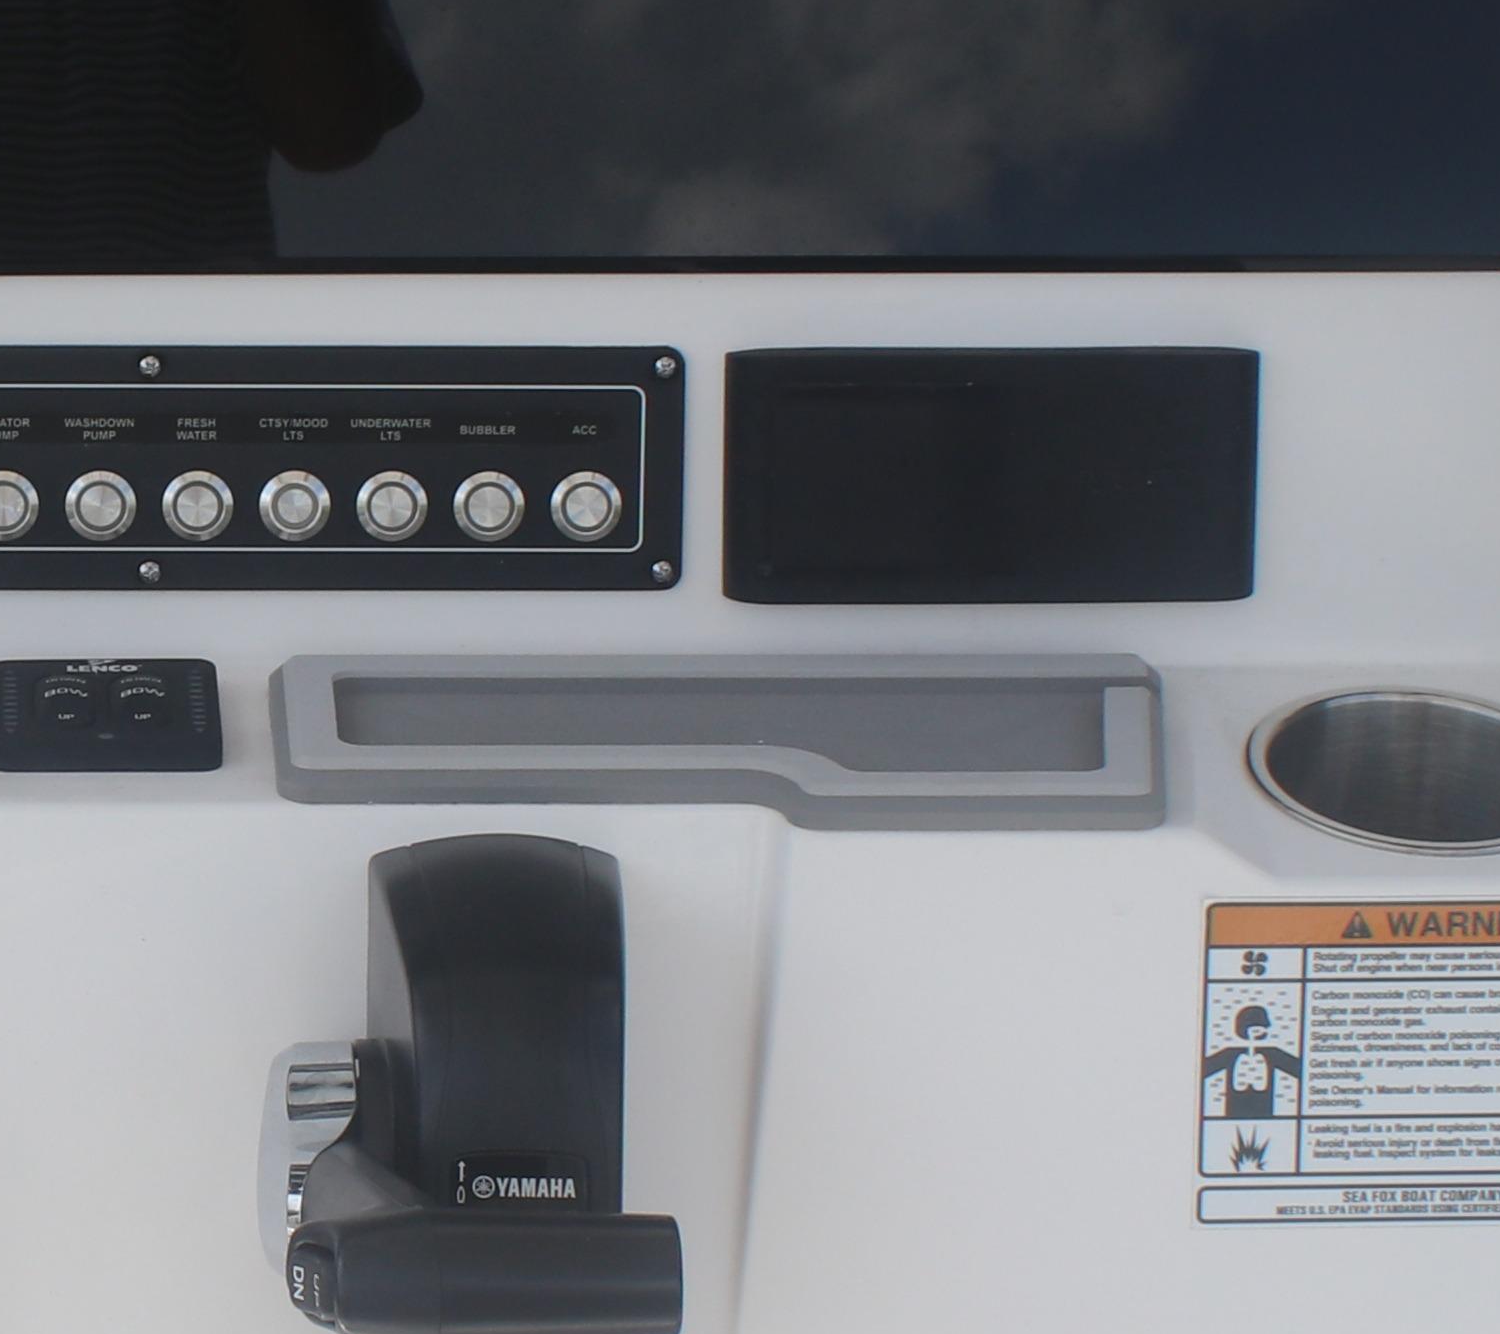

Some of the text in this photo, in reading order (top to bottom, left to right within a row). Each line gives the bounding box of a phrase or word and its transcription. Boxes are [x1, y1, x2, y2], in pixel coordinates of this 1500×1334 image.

[64, 418, 134, 428] WASHDOWN
[177, 418, 216, 428] FRESH
[259, 418, 328, 428] CTSY/MOOD
[351, 419, 431, 428] UNDERWATER
[83, 430, 116, 440] PUMP
[283, 430, 304, 440] LTS
[460, 425, 515, 435] BUBBLER
[572, 425, 597, 435] ACC
[176, 431, 217, 440] WATER
[380, 431, 401, 441] LTS
[67, 663, 137, 673] LENCO
[44, 688, 87, 698] BOW
[120, 687, 165, 698] BOW
[1314, 952, 1357, 964] Rotating
[1360, 952, 1406, 961] propeller
[1410, 953, 1431, 962] may
[1314, 963, 1337, 972] Shut
[1340, 961, 1356, 972] off
[1357, 965, 1392, 974] engine
[1395, 963, 1423, 972] when
[1426, 961, 1448, 971] near
[1451, 964, 1493, 972] persons
[1312, 990, 1350, 1000] Carbon
[1353, 991, 1404, 1000] monoxide
[1407, 989, 1431, 999] (CO)
[1433, 991, 1452, 999] can
[1455, 991, 1486, 999] cause
[1308, 1125, 1349, 1135] Leaking
[1351, 1124, 1371, 1133] fuel
[1374, 1125, 1383, 1133] is
[1386, 1125, 1392, 1133] a
[1395, 1123, 1412, 1132] fire
[1414, 1124, 1434, 1132] and
[1436, 1123, 1487, 1133] explosion
[496, 1178, 576, 1198] YAMAHA
[1344, 1191, 1367, 1202] SEA
[1373, 1191, 1396, 1202] FOX
[1402, 1190, 1435, 1202] BOAT
[293, 1264, 304, 1301] DN
